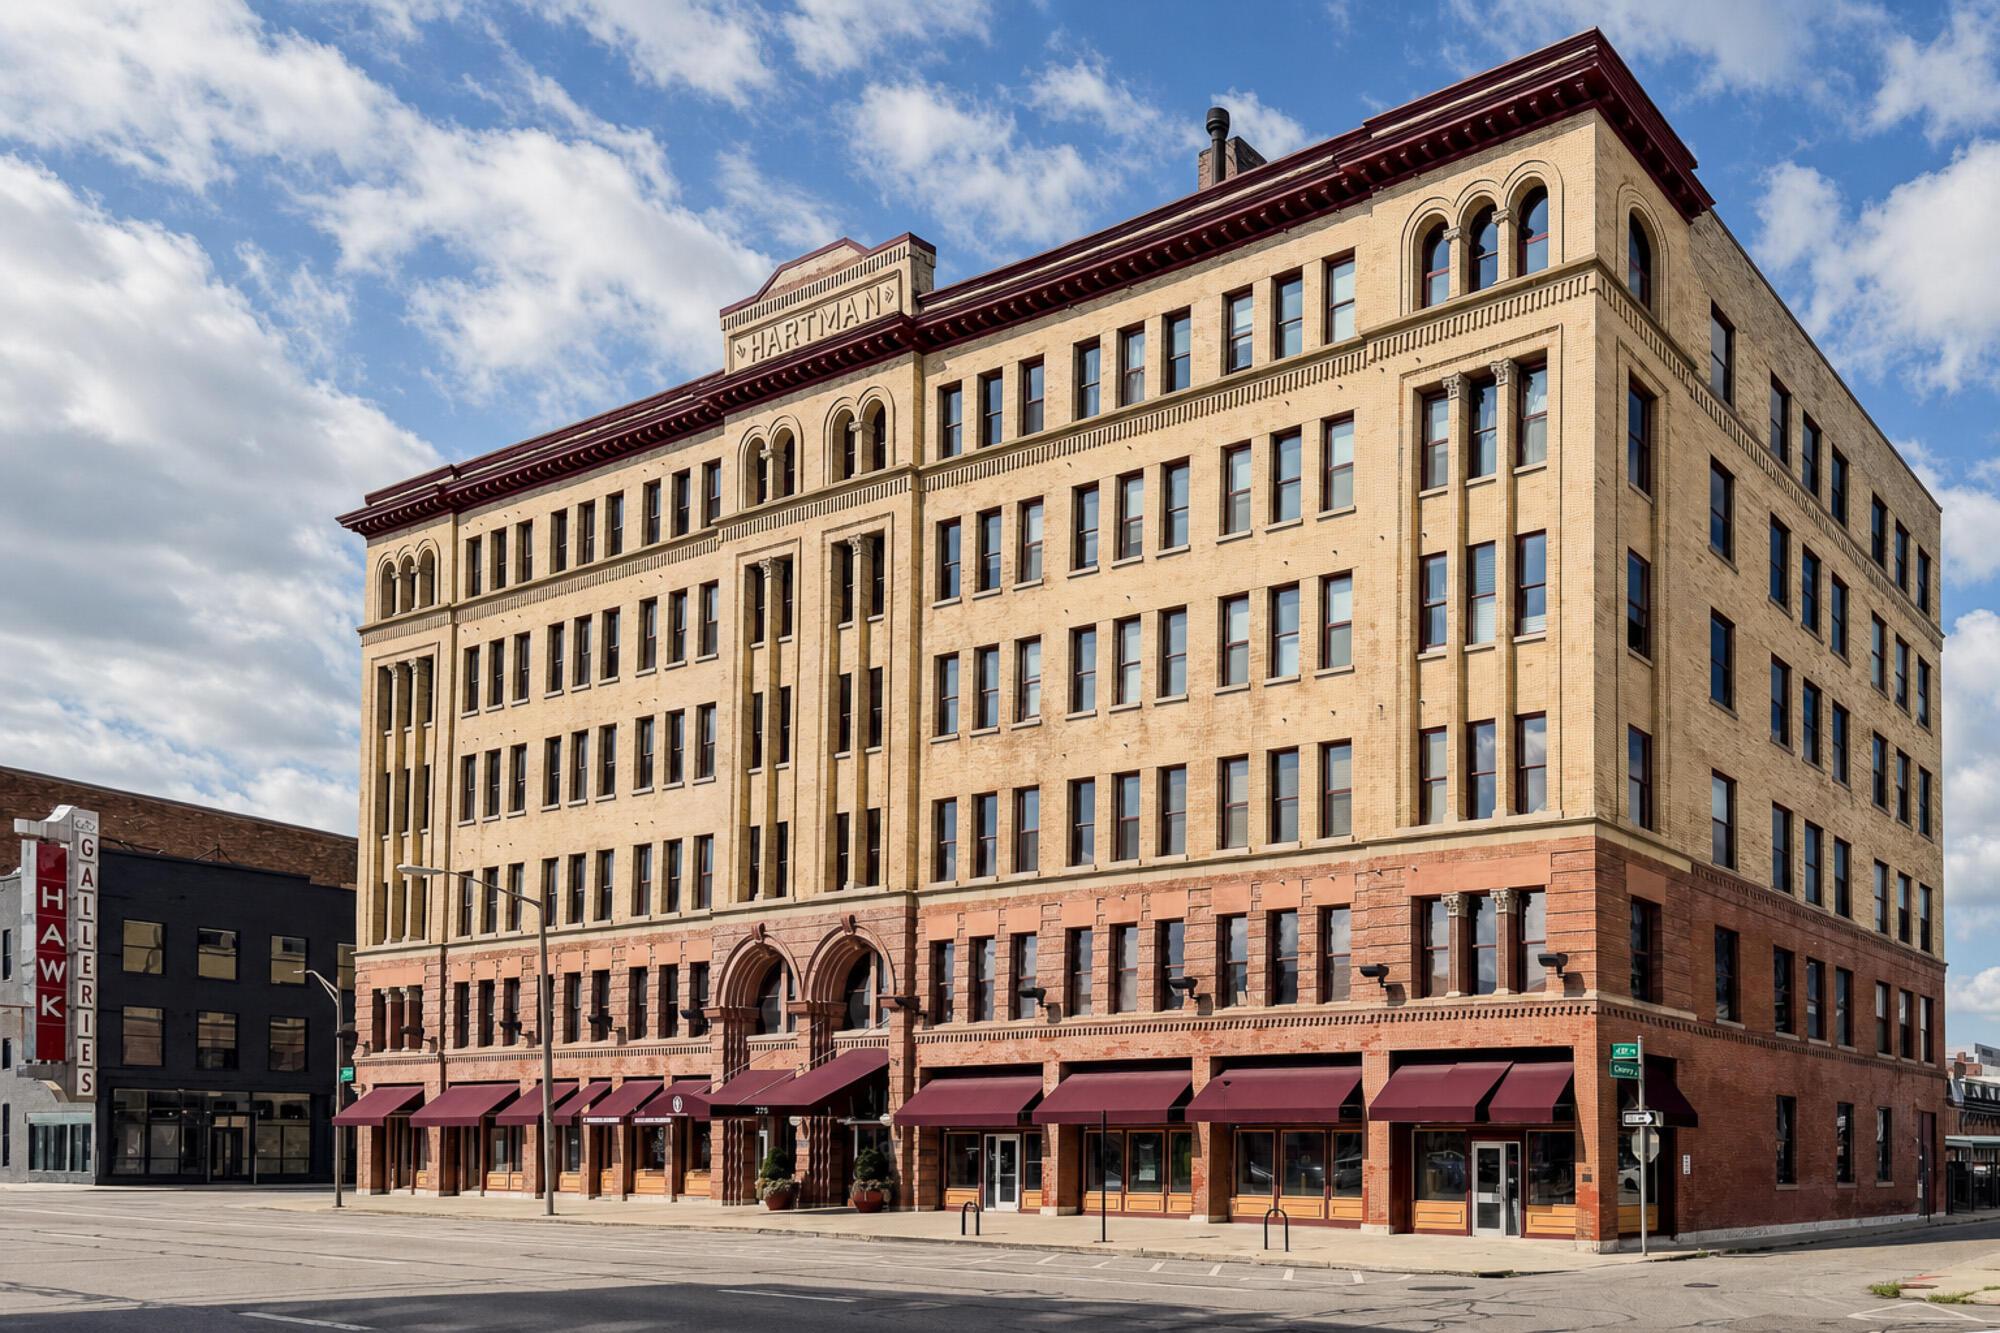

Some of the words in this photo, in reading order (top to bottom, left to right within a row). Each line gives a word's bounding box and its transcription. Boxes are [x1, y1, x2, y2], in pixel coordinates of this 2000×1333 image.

[751, 286, 881, 363] HARTMAN
[40, 886, 66, 1019] HAWK
[80, 838, 94, 1093] GALLERIES
